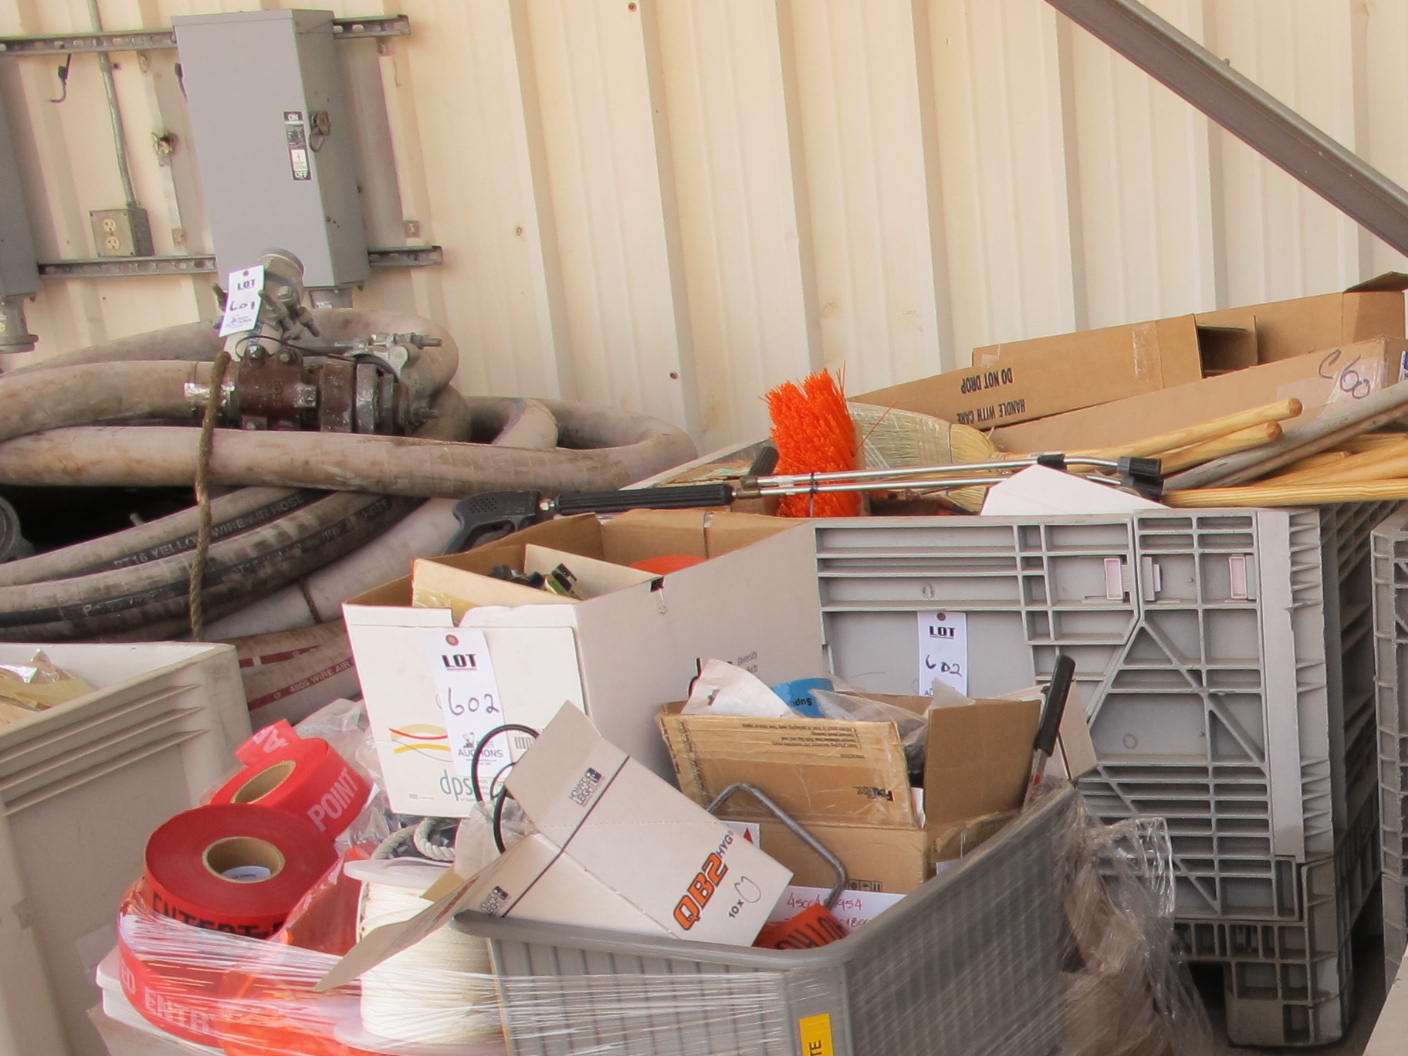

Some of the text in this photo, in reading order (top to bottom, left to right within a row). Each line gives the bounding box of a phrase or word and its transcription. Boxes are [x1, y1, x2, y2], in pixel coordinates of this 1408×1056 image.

[237, 279, 255, 290] LOT
[961, 367, 1013, 394] DO NOT DROP
[977, 406, 996, 423] WITH
[999, 399, 1026, 418] HANDLE
[929, 625, 956, 638] LOT
[442, 654, 477, 668] LOT
[448, 687, 500, 716] 602
[307, 767, 360, 832] POINT
[673, 852, 729, 931] QB2
